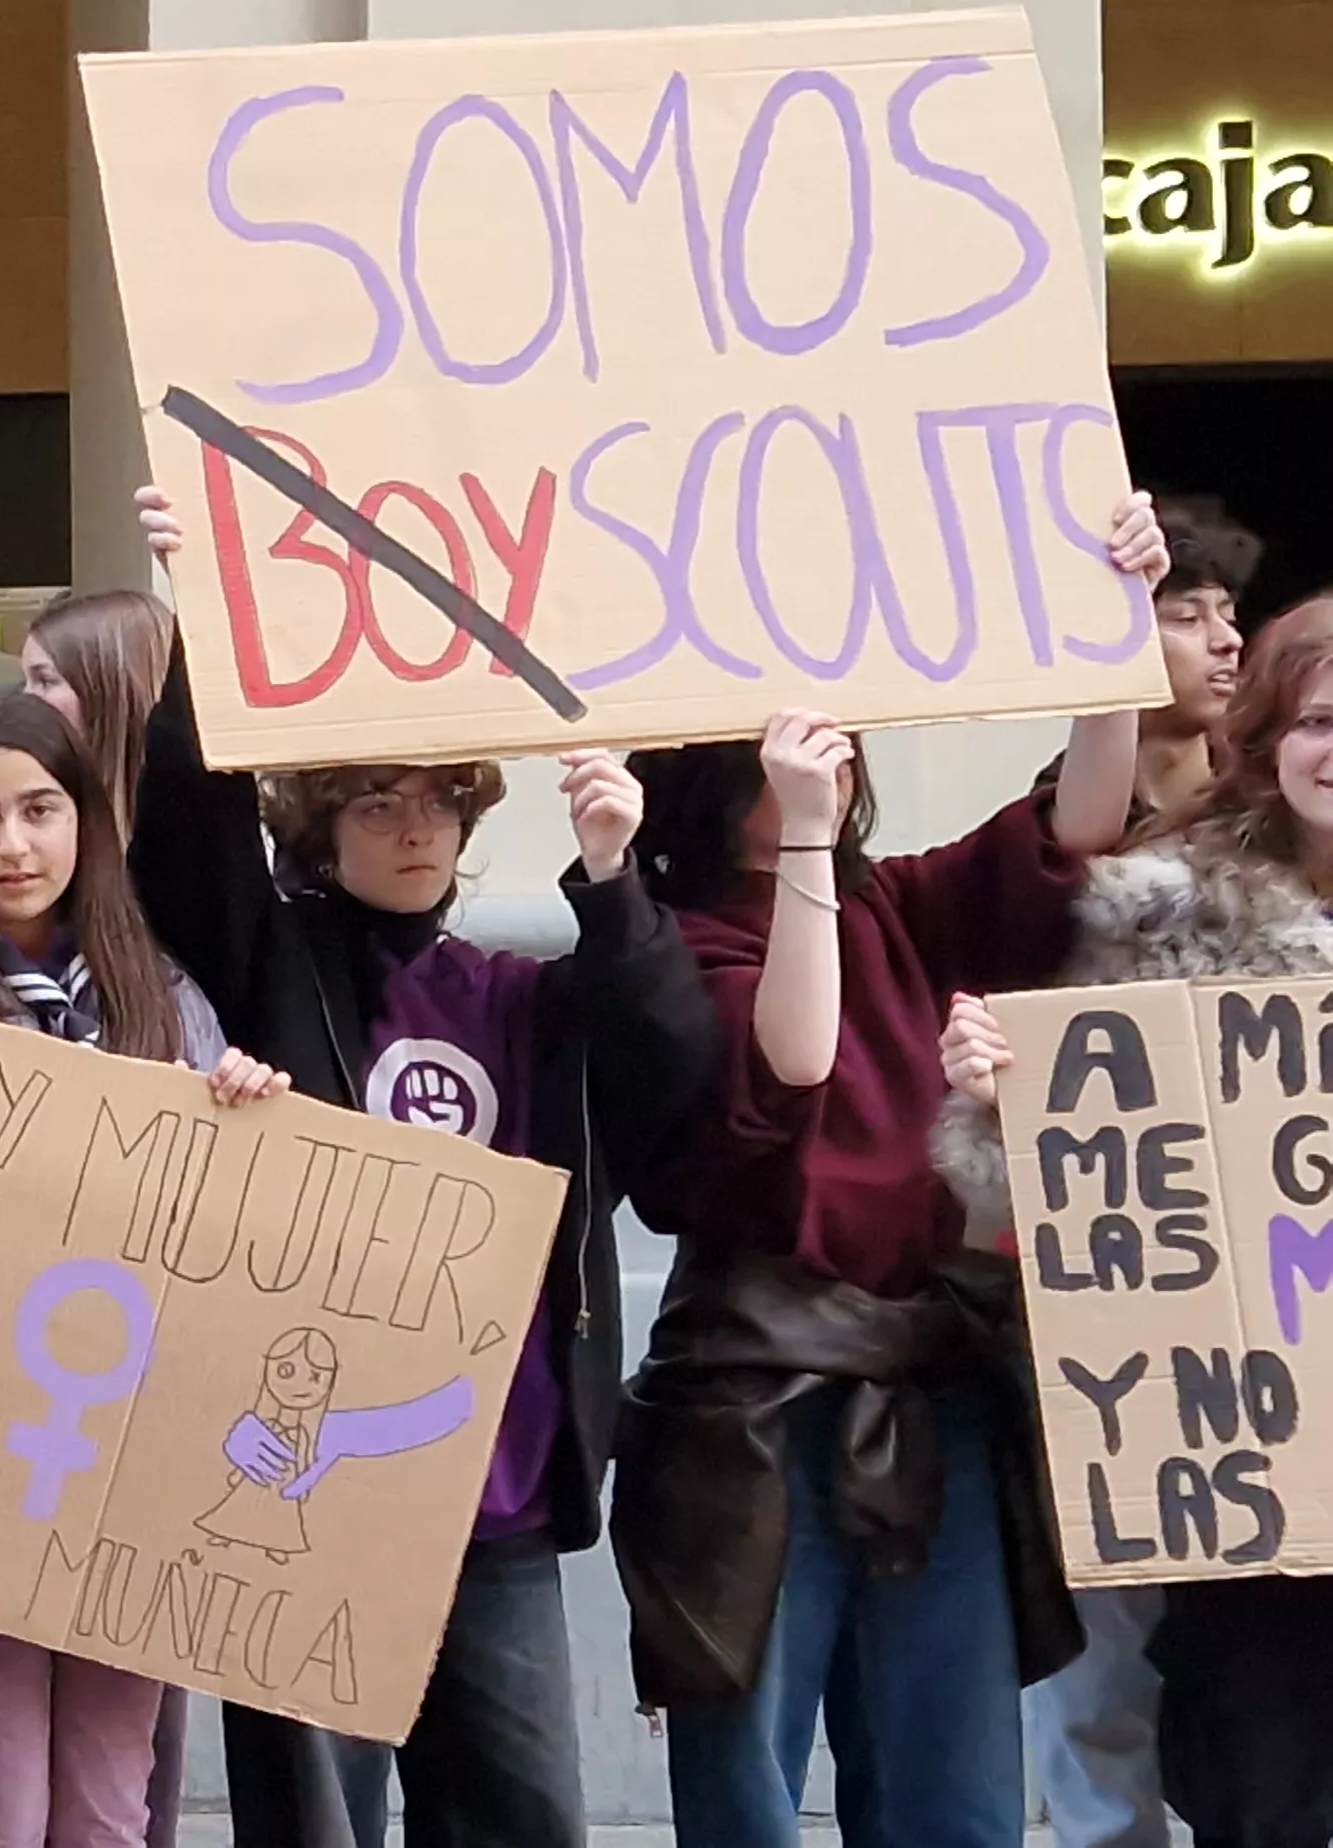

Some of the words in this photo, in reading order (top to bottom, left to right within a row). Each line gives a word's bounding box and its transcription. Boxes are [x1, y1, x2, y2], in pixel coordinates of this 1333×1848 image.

[208, 55, 1051, 404] SOMOS
[567, 404, 1154, 690] SCOUTS
[1045, 1009, 1158, 1114] A
[1035, 1121, 1211, 1213] ME
[1034, 1212, 1220, 1293] LAS
[1058, 1350, 1150, 1457] Y
[1171, 1345, 1300, 1450] NO
[1087, 1448, 1286, 1566] LAS
[24, 1529, 360, 1707] MUÑECA
